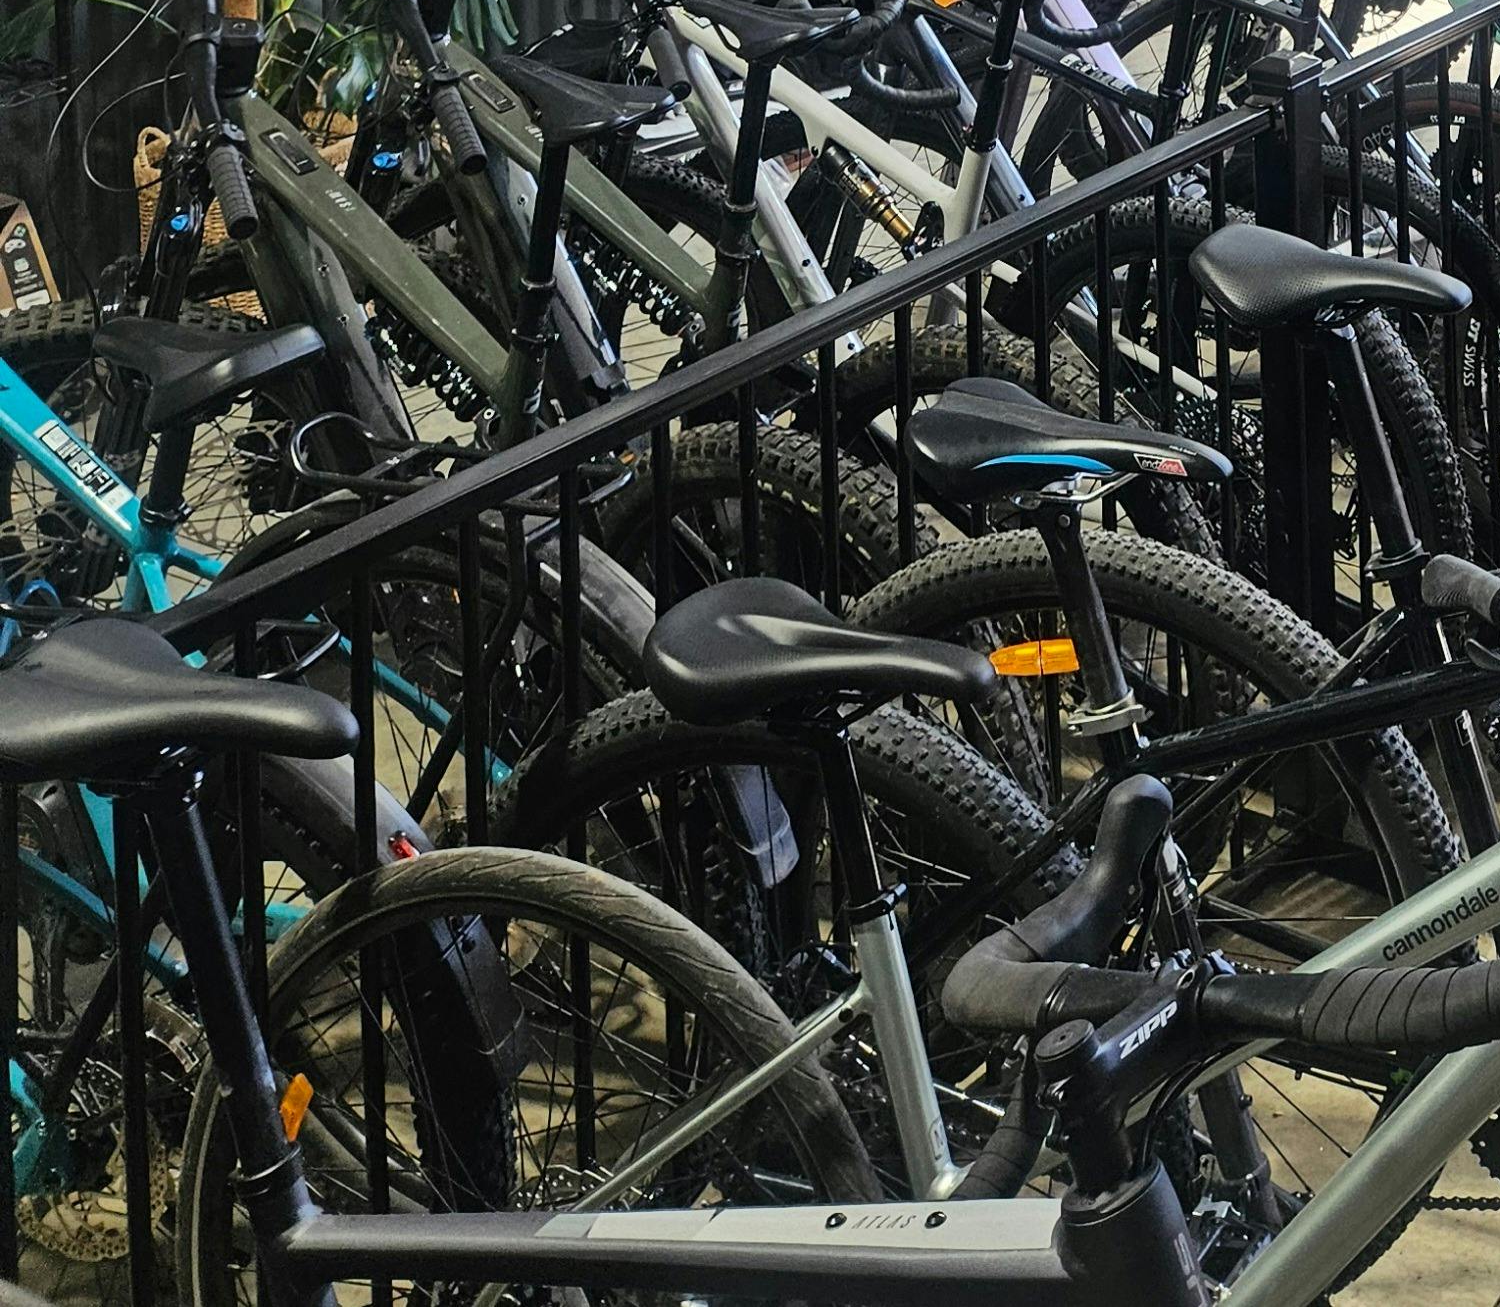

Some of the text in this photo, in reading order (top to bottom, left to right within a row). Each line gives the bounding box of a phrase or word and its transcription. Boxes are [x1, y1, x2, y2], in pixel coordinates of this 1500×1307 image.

[1464, 318, 1481, 388] DT SWISS
[1381, 883, 1500, 964] cannondale
[1120, 1001, 1178, 1060] ZIPP
[853, 1213, 917, 1230] ATLAS
